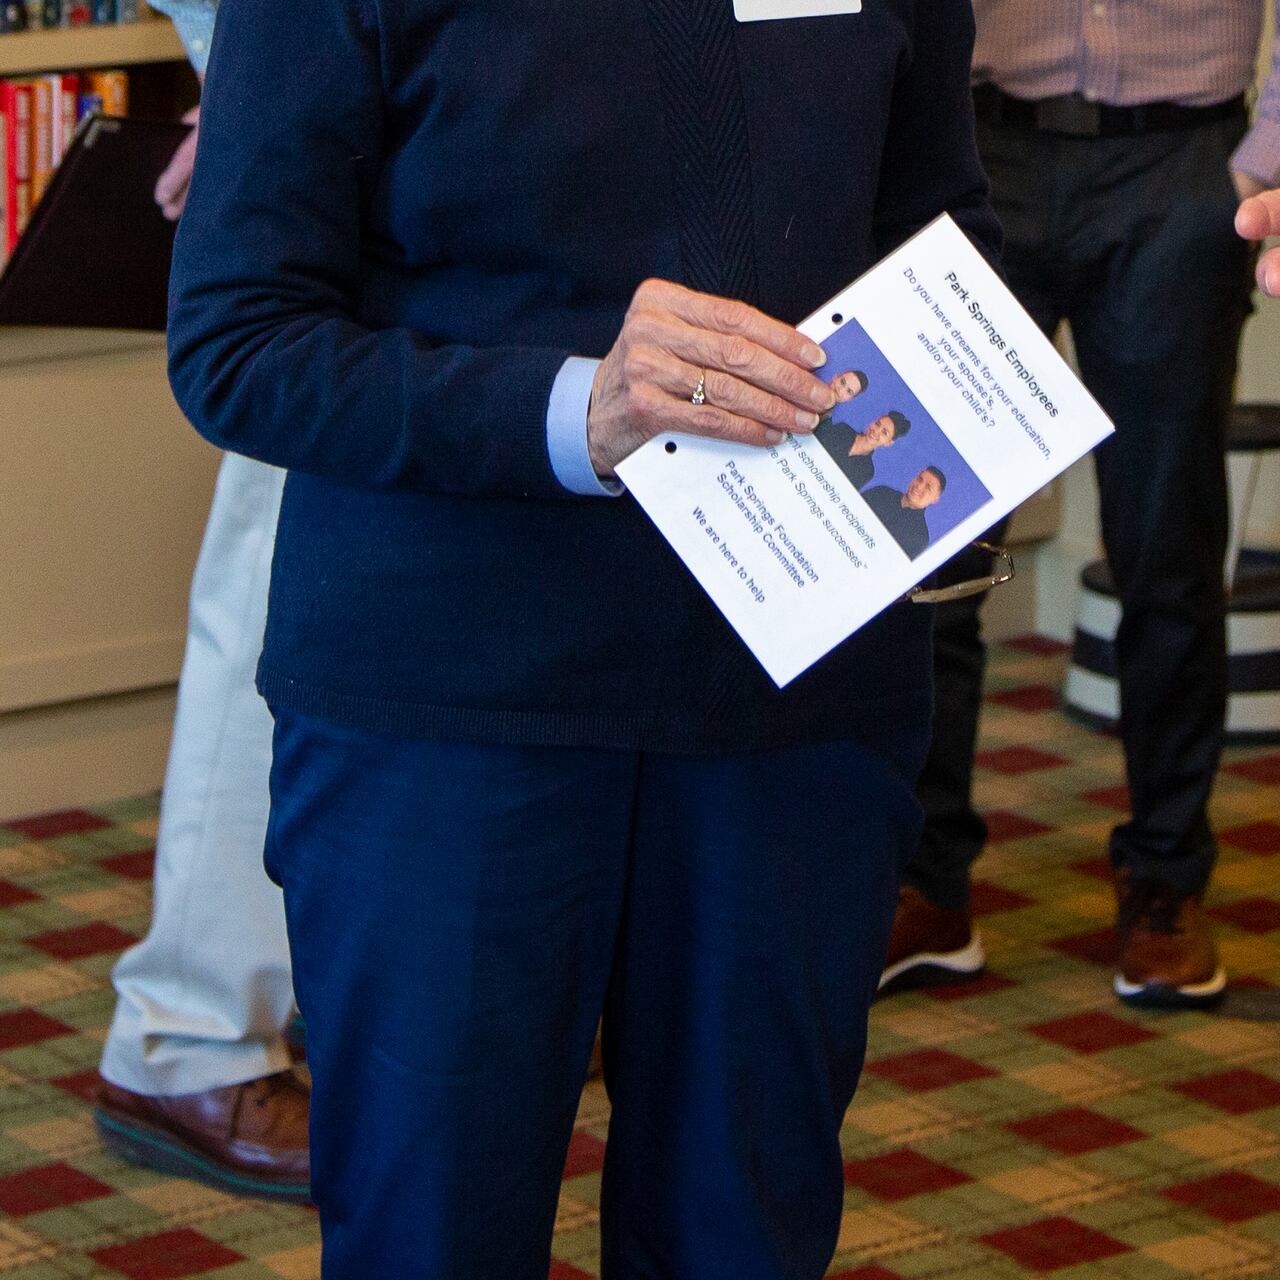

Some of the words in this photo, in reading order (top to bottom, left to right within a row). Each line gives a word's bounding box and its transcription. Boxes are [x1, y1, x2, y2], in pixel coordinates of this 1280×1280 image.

[902, 266, 917, 285] Do
[911, 283, 933, 305] you
[929, 301, 953, 330] have
[949, 328, 982, 368] dreams
[978, 364, 995, 383] for
[988, 380, 1014, 407] your
[916, 331, 946, 365] and/or
[939, 363, 964, 389] your
[960, 389, 996, 428] child's?
[935, 336, 960, 361] your
[943, 270, 970, 304] Park
[966, 300, 1007, 351] Springs
[1003, 346, 1059, 418] Employees
[715, 471, 764, 534] Scholarship
[761, 531, 805, 589] Committee
[723, 458, 746, 487] Park
[742, 483, 776, 526] Springs
[772, 522, 820, 584] Foundation
[775, 457, 797, 483] Park
[793, 481, 825, 520] Springs
[796, 450, 841, 504] scholarship
[837, 503, 876, 550] recipients
[691, 504, 707, 527] We
[703, 524, 721, 545] are
[717, 540, 739, 568] here
[735, 564, 748, 580] to
[744, 576, 766, 604] help
